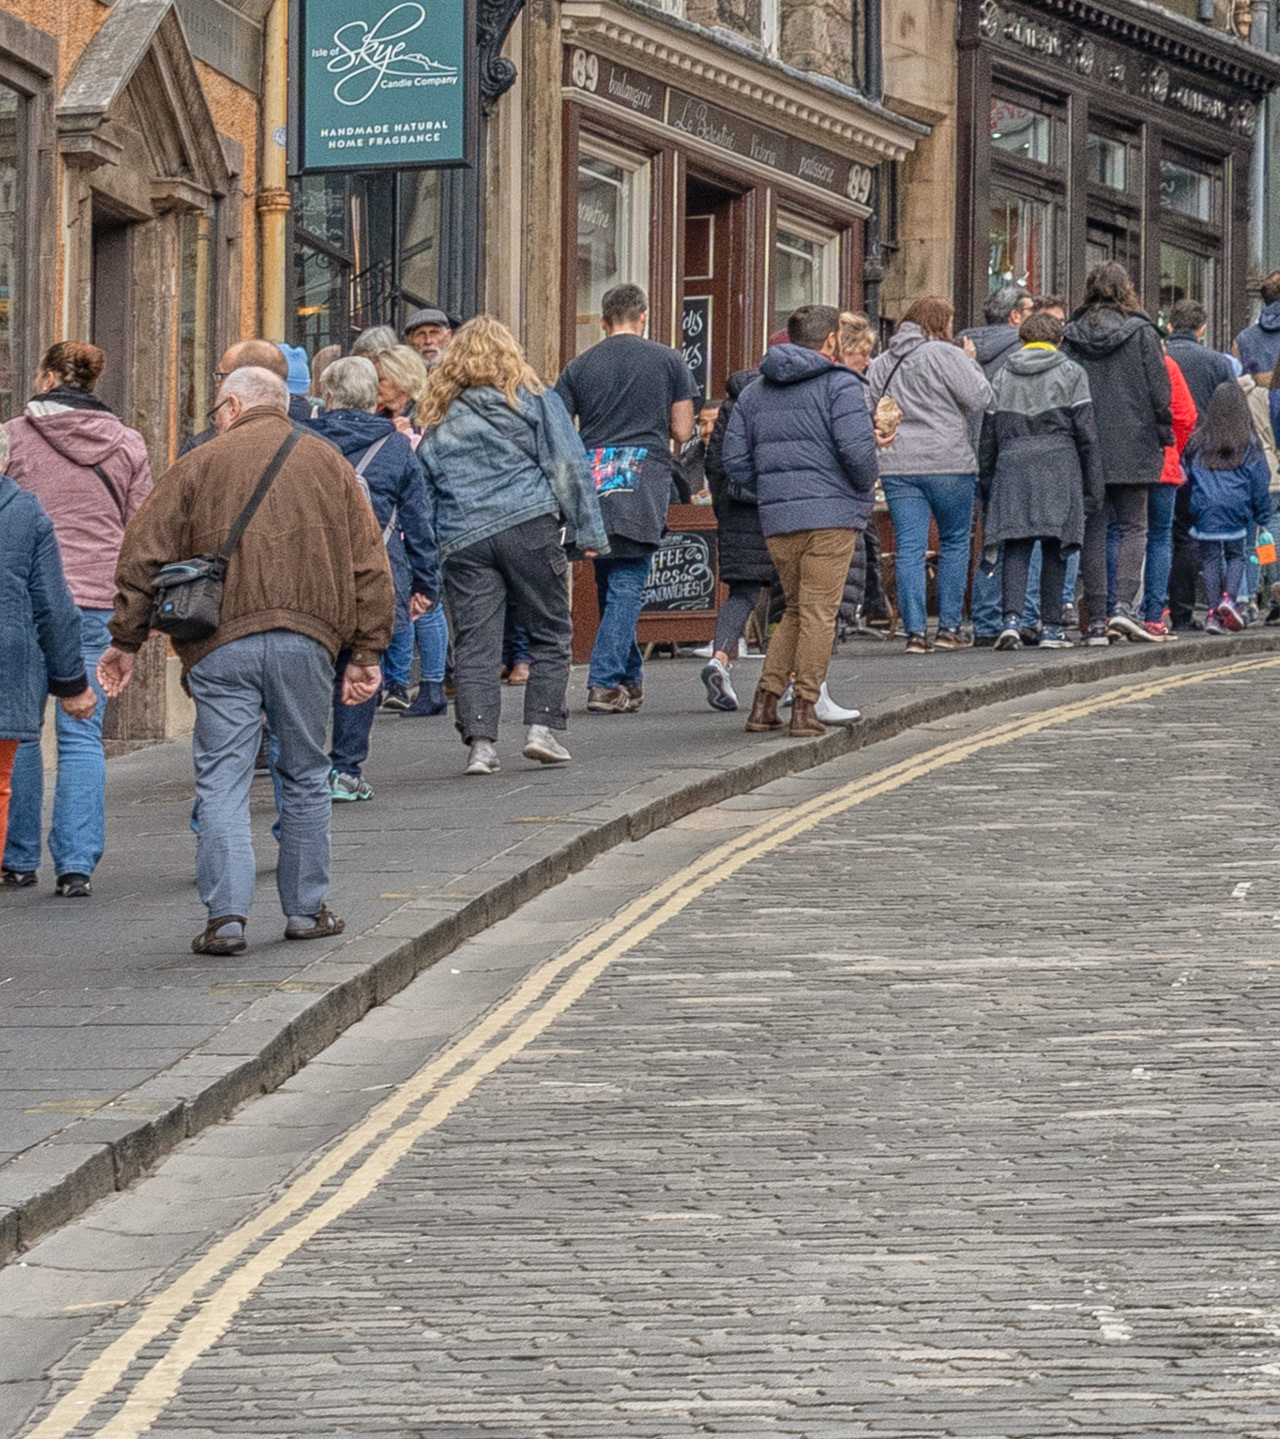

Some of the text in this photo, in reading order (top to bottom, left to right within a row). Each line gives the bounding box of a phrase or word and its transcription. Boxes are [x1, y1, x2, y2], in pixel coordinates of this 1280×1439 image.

[311, 47, 340, 57] Isle of
[326, 1, 426, 106] Skye
[572, 48, 600, 92] 89
[380, 76, 458, 89] Candle Company
[674, 99, 693, 131] La
[320, 120, 448, 138] HANDMADE NATURAL
[328, 133, 441, 149] HOME FRAGRANCE
[848, 162, 872, 204] 89
[650, 549, 684, 569] FFEE
